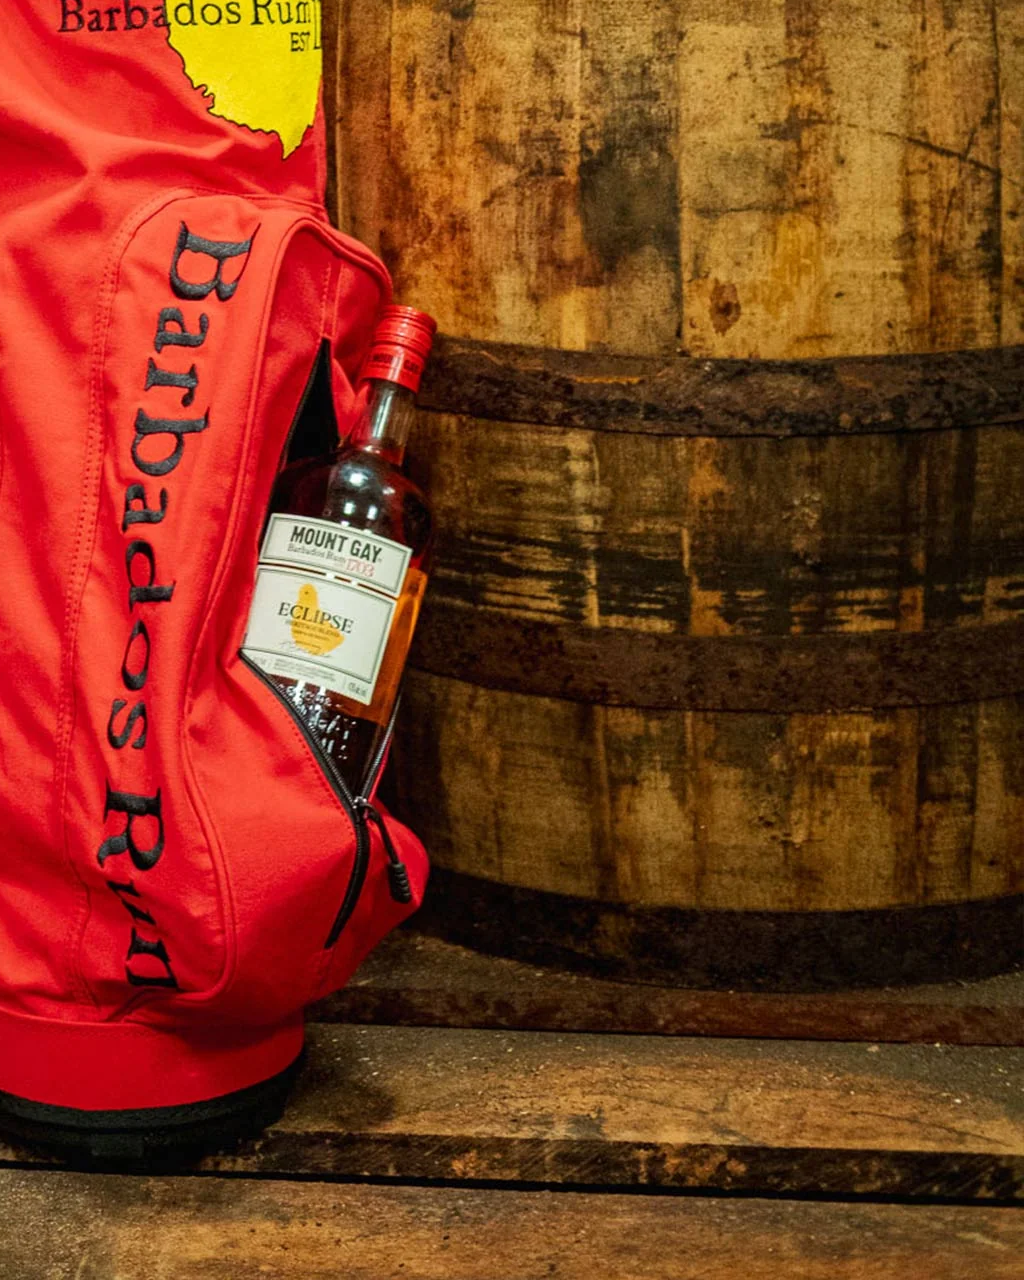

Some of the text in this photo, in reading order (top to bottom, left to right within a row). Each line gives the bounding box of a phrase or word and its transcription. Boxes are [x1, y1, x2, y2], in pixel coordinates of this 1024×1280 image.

[106, 220, 262, 752] Barbados
[289, 525, 383, 563] MOUNT GAY
[345, 558, 376, 578] 1703
[278, 601, 355, 634] ECLIPSE
